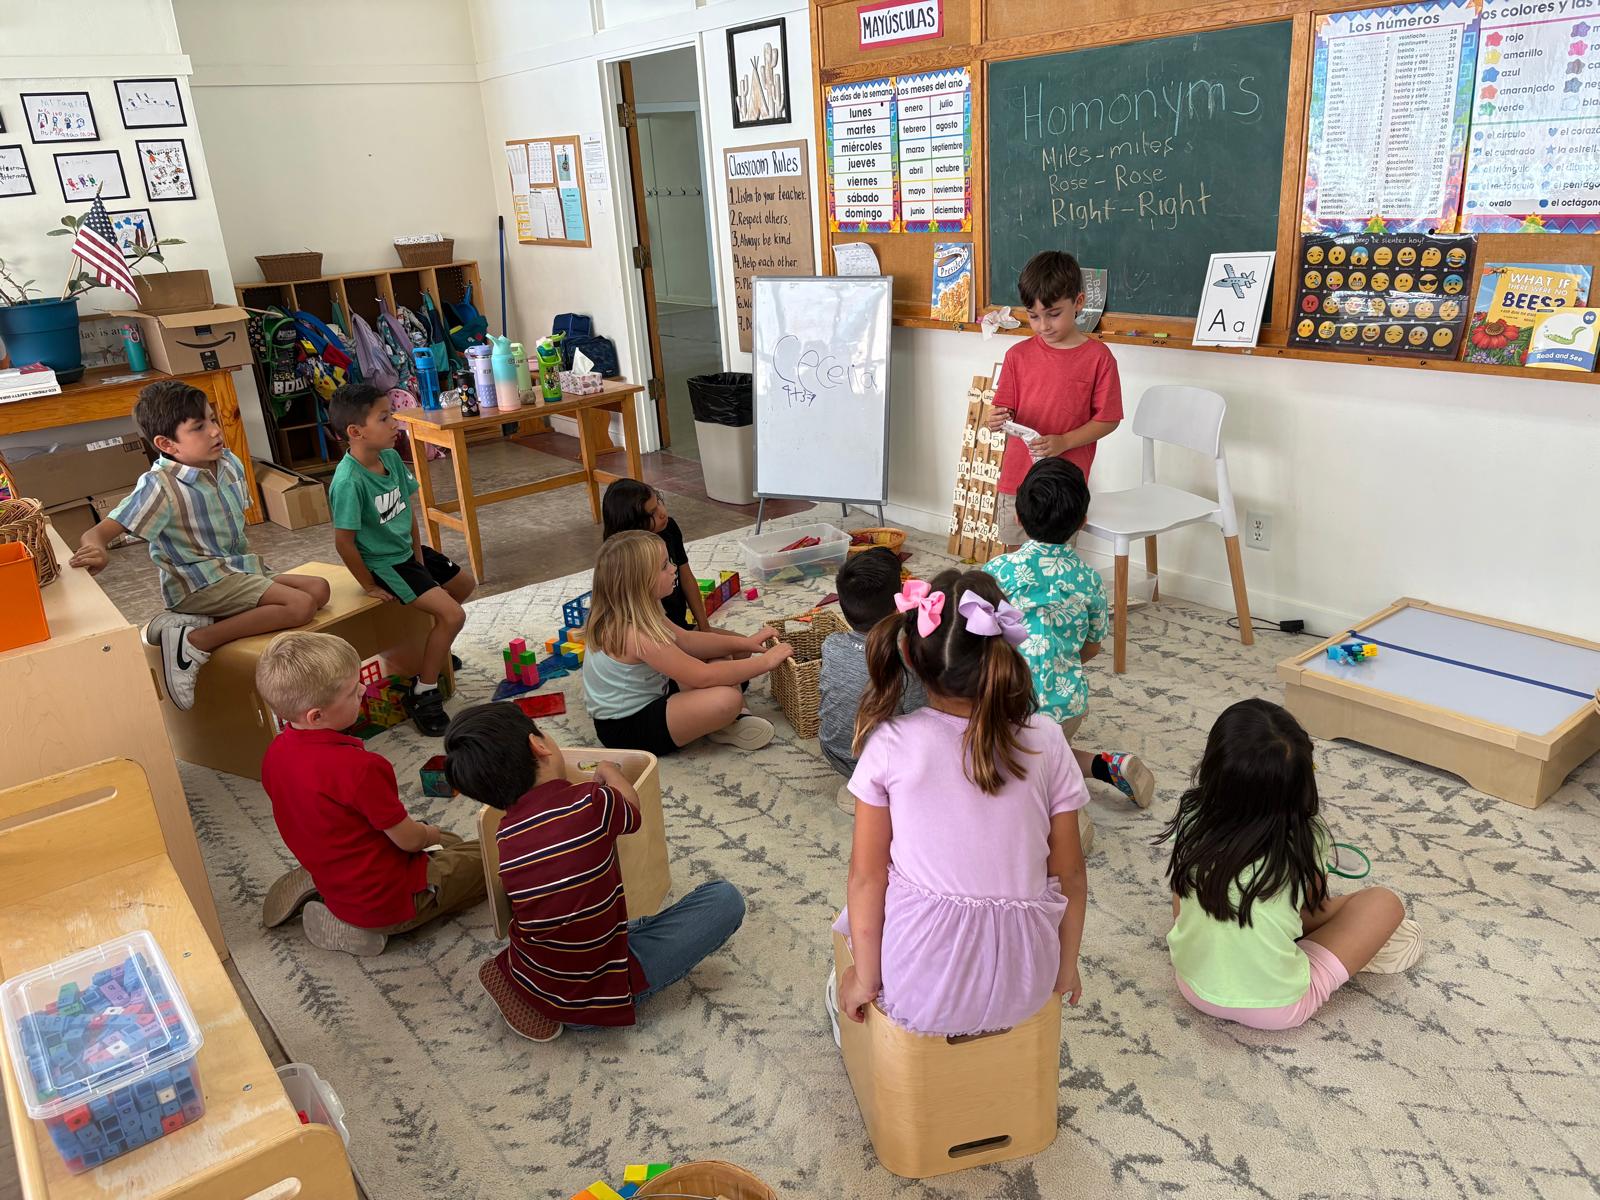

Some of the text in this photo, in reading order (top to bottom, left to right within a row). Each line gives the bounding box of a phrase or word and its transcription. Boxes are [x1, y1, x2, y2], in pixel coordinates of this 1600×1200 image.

[1481, 9, 1497, 20] os
[1501, 2, 1555, 18] colores
[1558, 0, 1568, 13] y
[862, 6, 935, 39] MAYÚSCULAS
[1349, 13, 1440, 34] Los números
[1505, 33, 1524, 43] rojo
[1504, 48, 1543, 60] amarillo
[1501, 68, 1520, 77] azul
[897, 78, 963, 96] Los meses del año
[1500, 84, 1555, 96] anaranjado
[830, 89, 893, 103] Los días de la semana
[905, 105, 924, 113] enero
[939, 98, 954, 111] julio
[1024, 76, 1260, 141] Homonyms
[1498, 104, 1524, 112] verde
[849, 108, 872, 118] lunes
[847, 124, 876, 136] martes
[903, 125, 926, 134] febrero
[936, 121, 958, 132] agosto
[1560, 128, 1569, 136] el
[1487, 130, 1526, 139] el círculo
[842, 141, 883, 153] miércoles
[906, 146, 926, 154] marzo
[932, 142, 963, 153] septiembre
[1485, 147, 1536, 156] el cuadrado
[1558, 145, 1567, 154] la
[729, 150, 799, 176] Classroom Rules
[1042, 144, 1092, 171] Miles
[848, 158, 876, 171] jueves
[936, 164, 960, 173] octubre
[909, 166, 924, 175] abril
[847, 176, 878, 186] viernes
[1049, 174, 1088, 195] Rose
[1115, 164, 1167, 191] Rose
[908, 187, 926, 196] mayo
[934, 185, 963, 194] noviembre
[755, 187, 762, 203] to
[763, 191, 775, 205] your
[847, 192, 879, 203] sábado
[1551, 199, 1560, 207] el
[845, 209, 882, 221] domingo
[910, 207, 926, 217] junio
[934, 206, 964, 214] diciembre
[765, 210, 791, 226] others.
[763, 232, 771, 246] be
[758, 256, 775, 267] each
[1510, 273, 1571, 289] WHAT IF
[1508, 284, 1568, 296] THERE WERE NO
[1502, 292, 1566, 311] BEES?
[1208, 309, 1245, 333] A a
[99, 328, 109, 337] is
[1570, 354, 1583, 362] See
[992, 435, 1000, 448] 5
[958, 464, 966, 473] 10
[976, 464, 984, 476] 11
[989, 468, 997, 480] 12
[954, 490, 961, 501] 17
[972, 495, 979, 505] 18
[982, 497, 990, 509] 19
[963, 522, 971, 533] 25
[980, 525, 988, 536] 26
